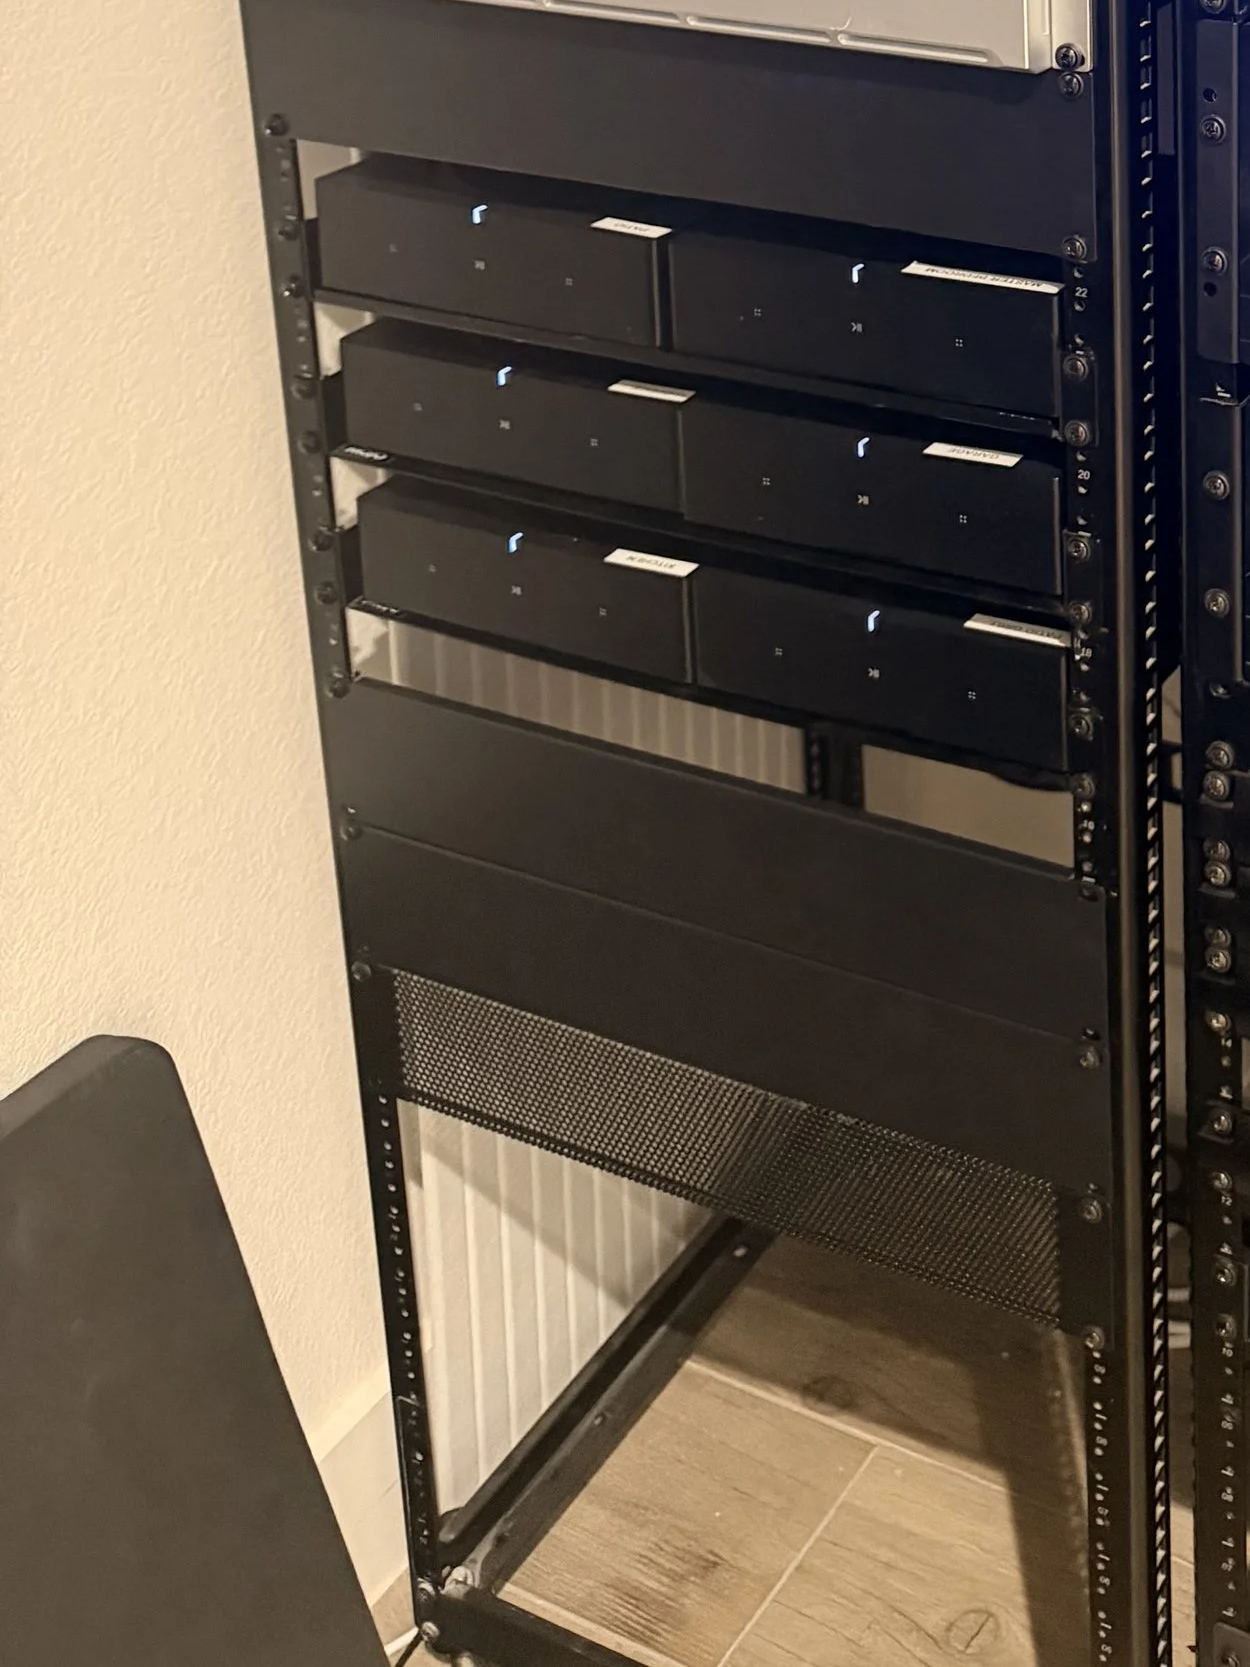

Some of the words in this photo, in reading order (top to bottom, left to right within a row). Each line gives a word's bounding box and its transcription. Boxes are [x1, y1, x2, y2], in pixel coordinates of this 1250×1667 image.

[925, 267, 989, 281] BEDROOM
[990, 276, 1043, 288] MASTER
[1075, 287, 1088, 298] 22
[947, 447, 1001, 461] GARAGE
[1077, 469, 1091, 480] 20
[625, 555, 677, 570] KITCHEN
[1080, 647, 1093, 658] 18
